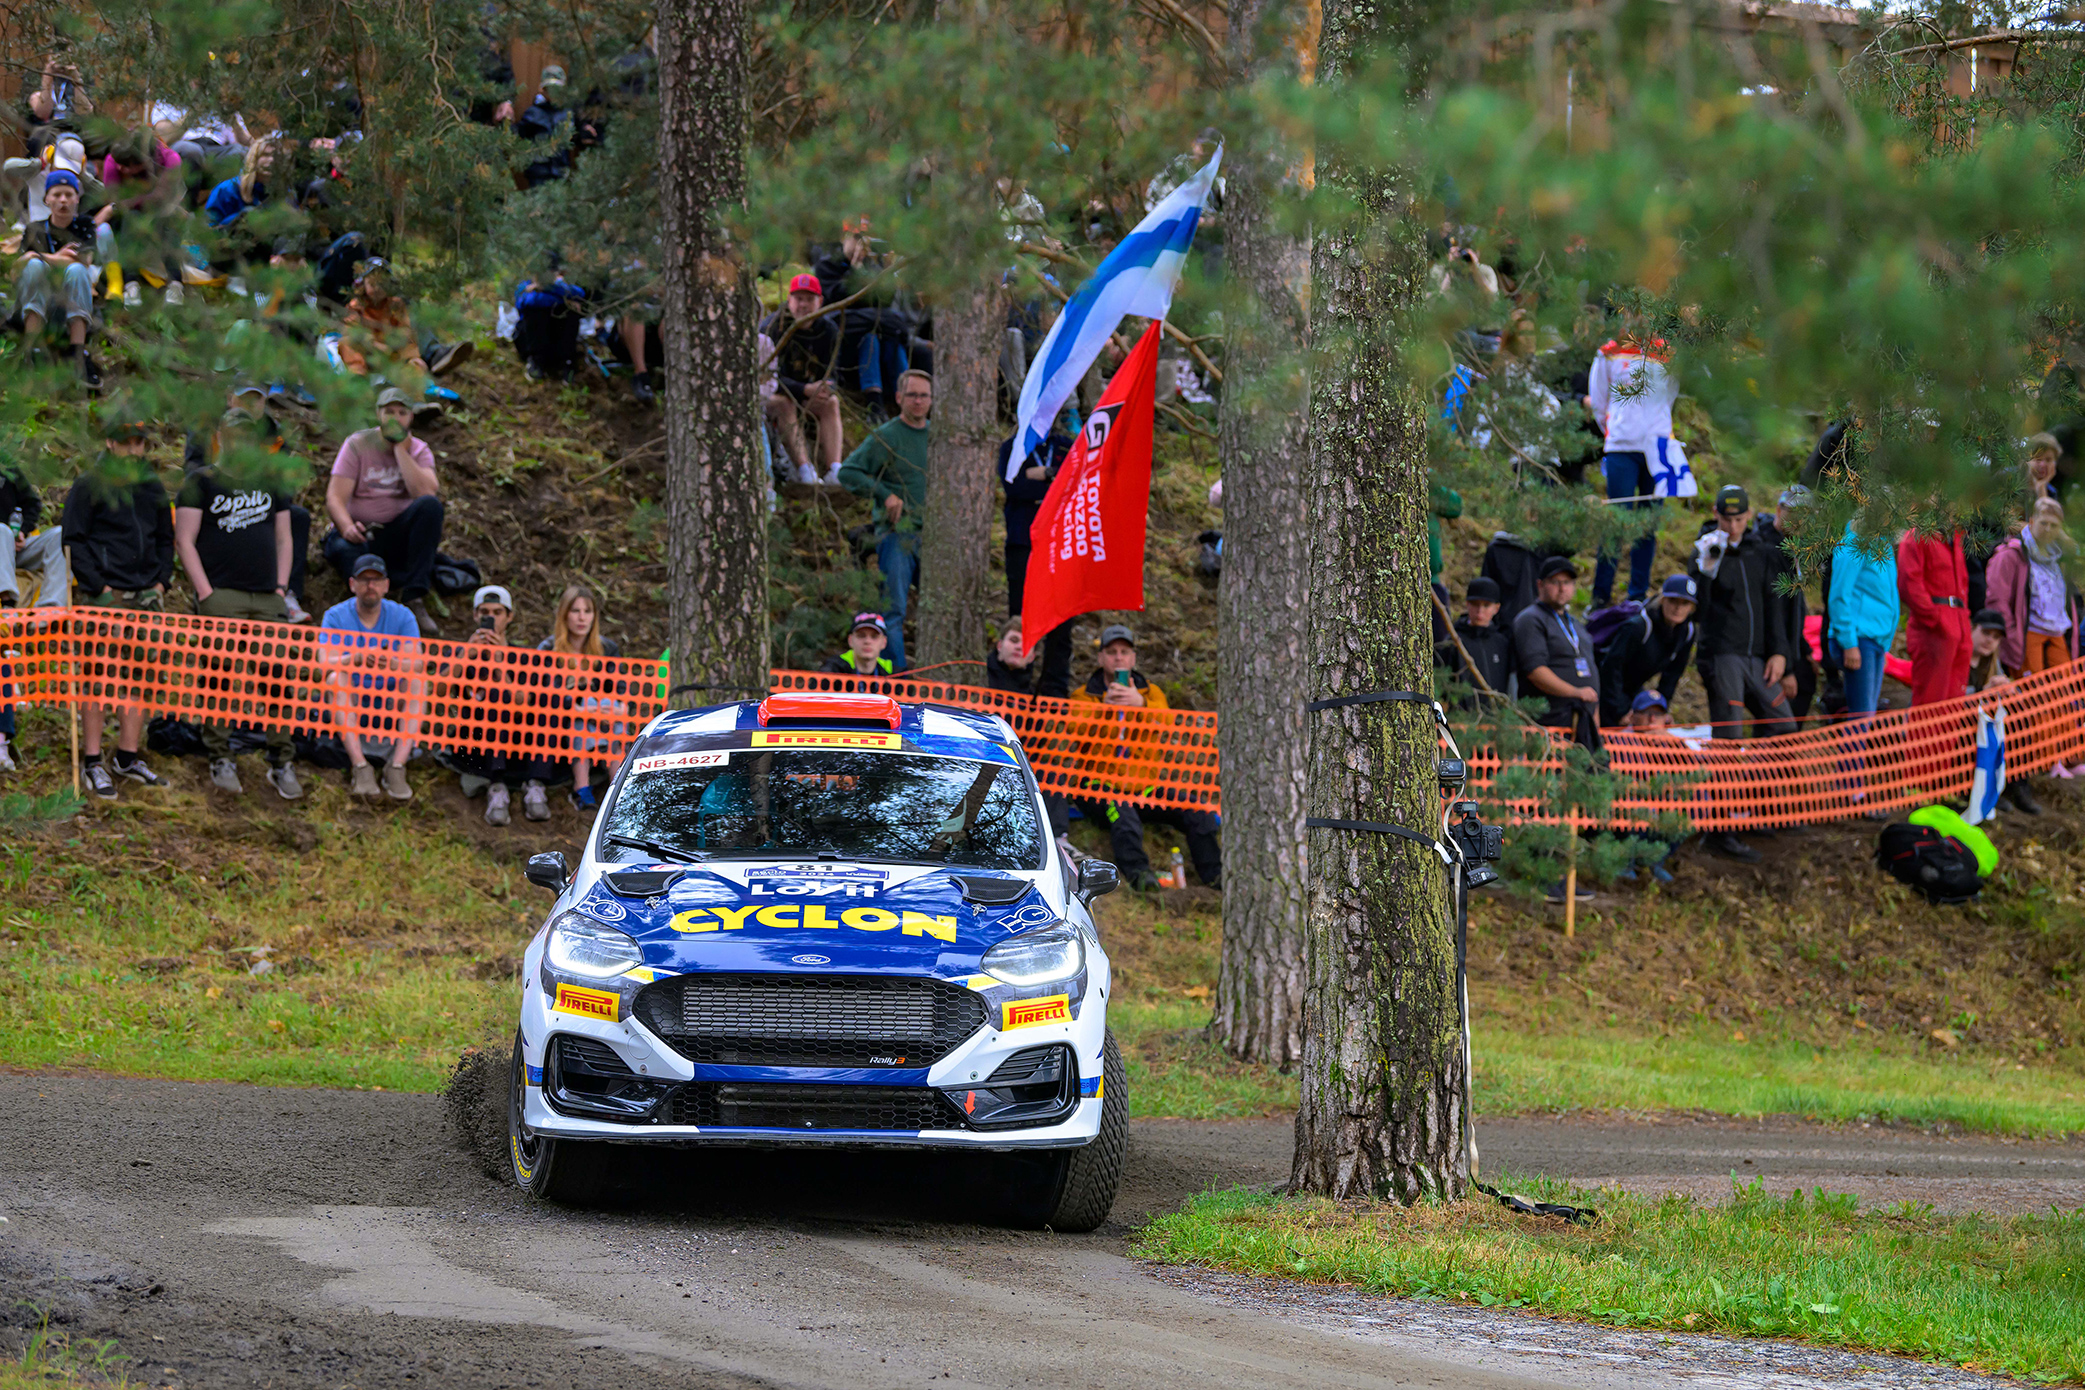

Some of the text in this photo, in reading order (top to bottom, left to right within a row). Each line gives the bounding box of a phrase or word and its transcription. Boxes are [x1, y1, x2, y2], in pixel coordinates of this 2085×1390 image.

[210, 490, 273, 515] Esprit
[1086, 470, 1106, 563] TOYOTA
[767, 734, 889, 746] PIRELLI
[639, 755, 722, 771] NB-4627
[669, 904, 957, 943] CYCLON
[559, 989, 614, 1016] PIRELLI
[1008, 1000, 1066, 1026] PIRELLI
[869, 1056, 906, 1066] Rally3
